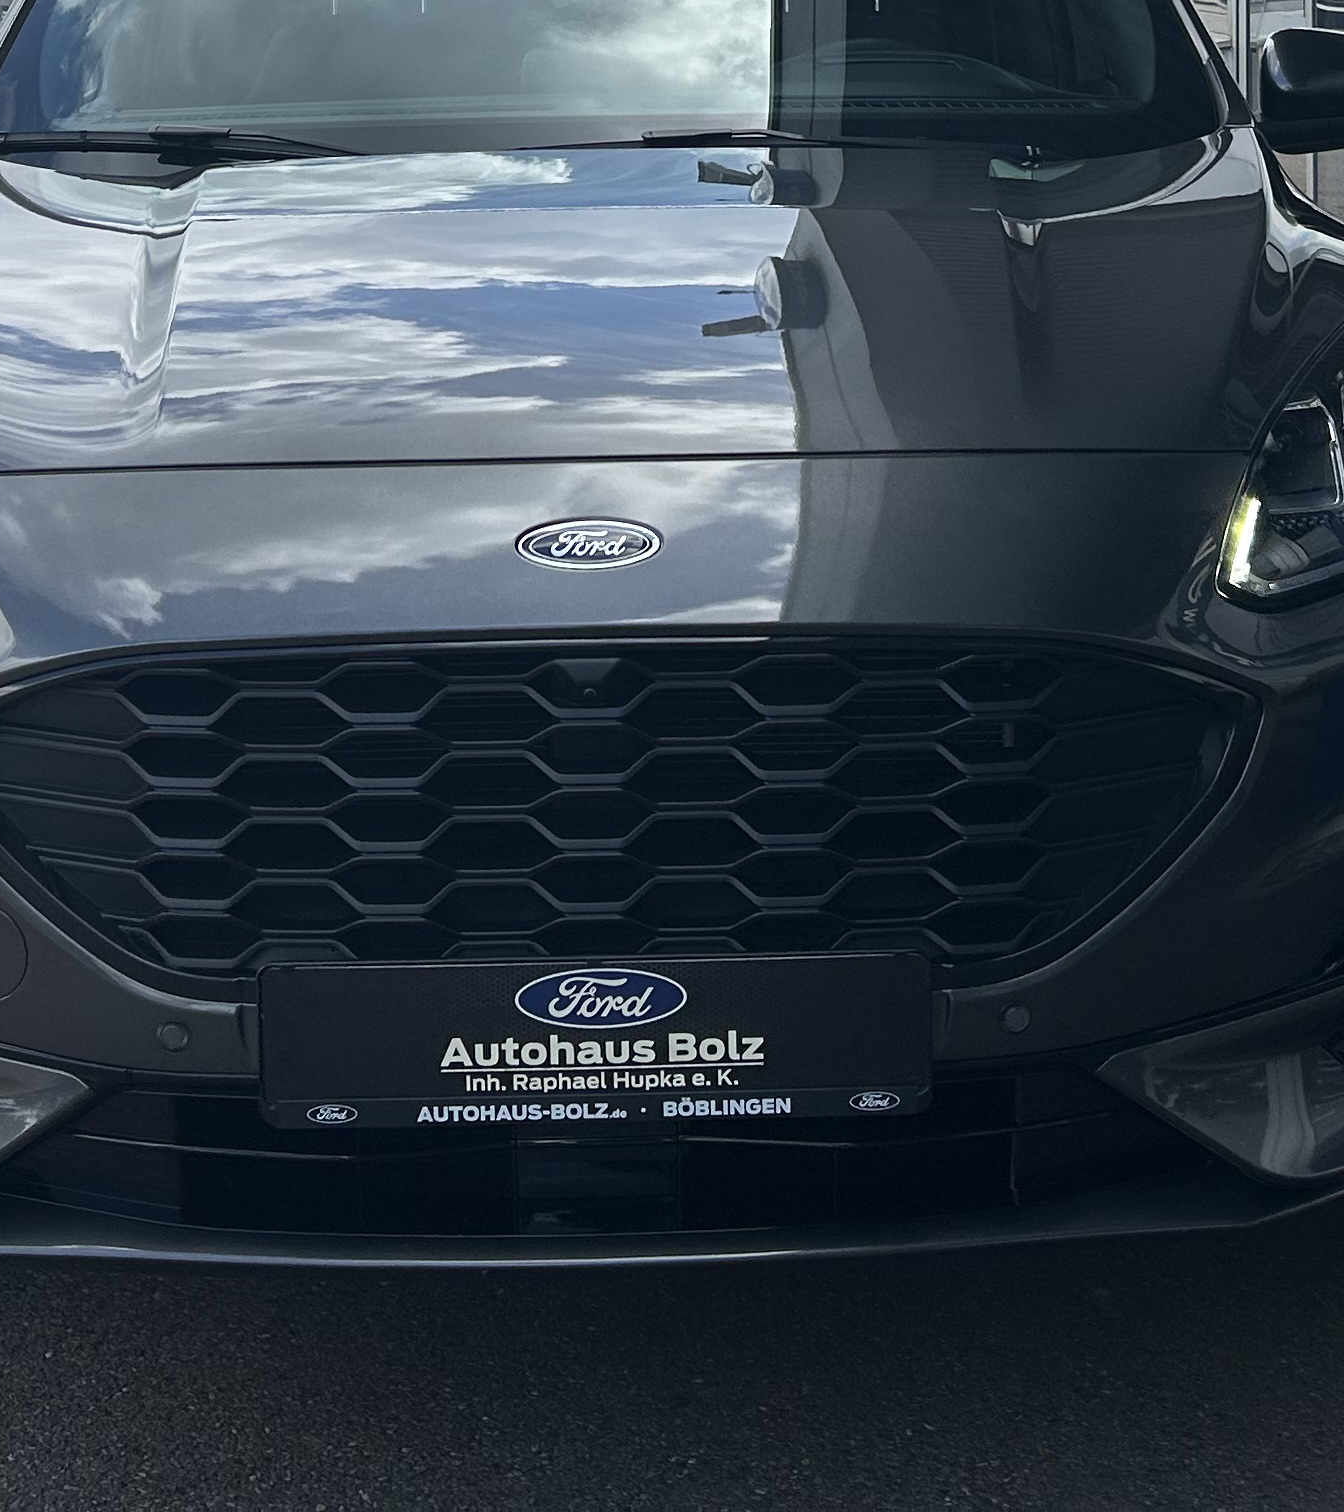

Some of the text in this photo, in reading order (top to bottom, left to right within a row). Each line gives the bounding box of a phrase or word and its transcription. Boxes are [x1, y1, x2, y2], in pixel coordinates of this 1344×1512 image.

[439, 1029, 765, 1068] Autohaus Bolz
[465, 1074, 507, 1092] Inh.
[512, 1071, 607, 1093] Raphael
[612, 1069, 687, 1091] Hupka
[662, 1096, 792, 1118] BÖBLINGEN
